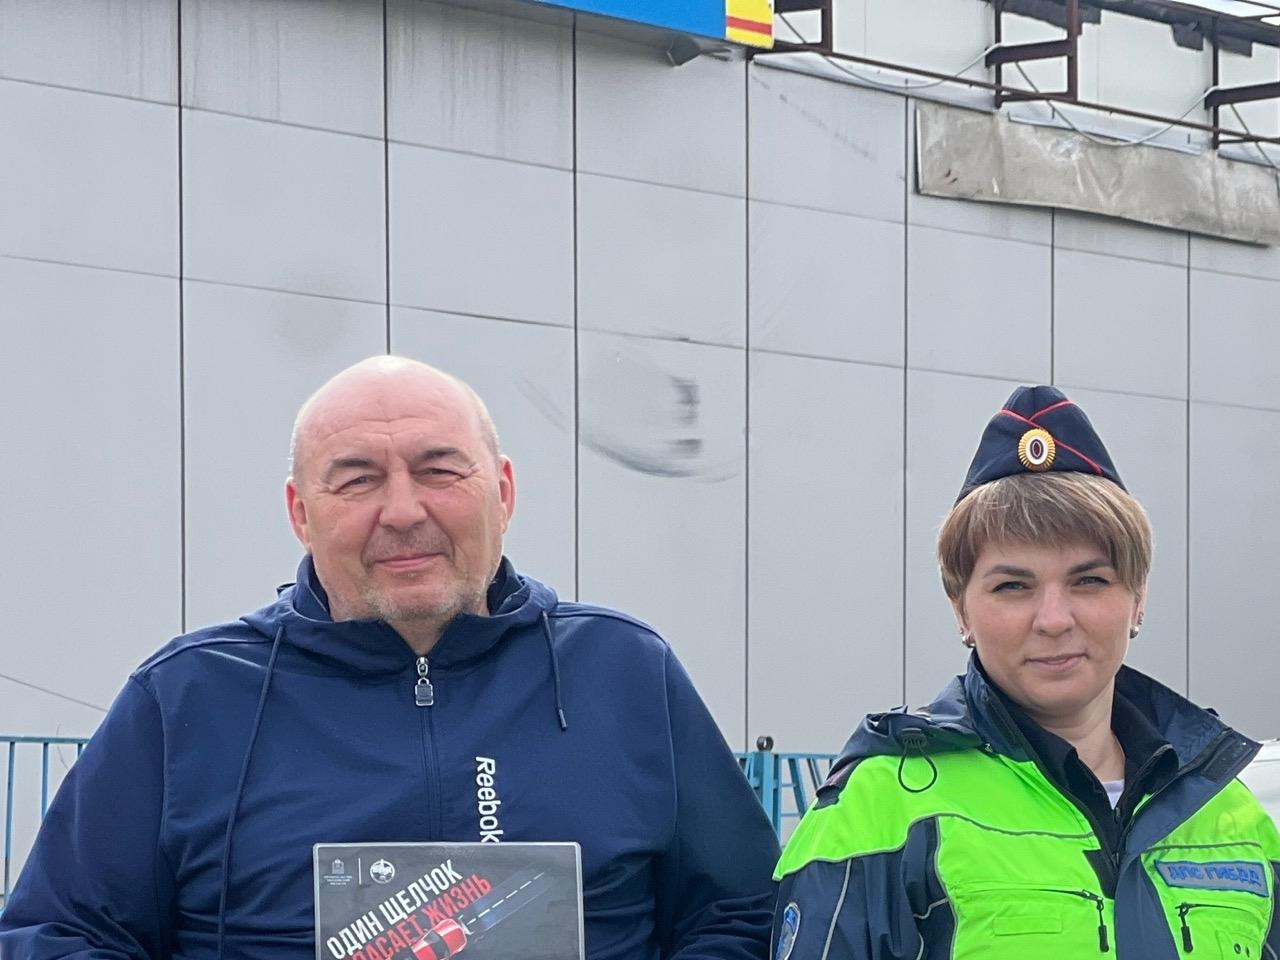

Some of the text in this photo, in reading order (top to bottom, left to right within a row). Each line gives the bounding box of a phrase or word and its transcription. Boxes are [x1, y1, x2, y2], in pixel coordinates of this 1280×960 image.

[476, 756, 504, 843] Reebok
[326, 858, 463, 960] ОДИН ЩЕЛЧОК
[421, 873, 493, 925] ЖИЗНЬ
